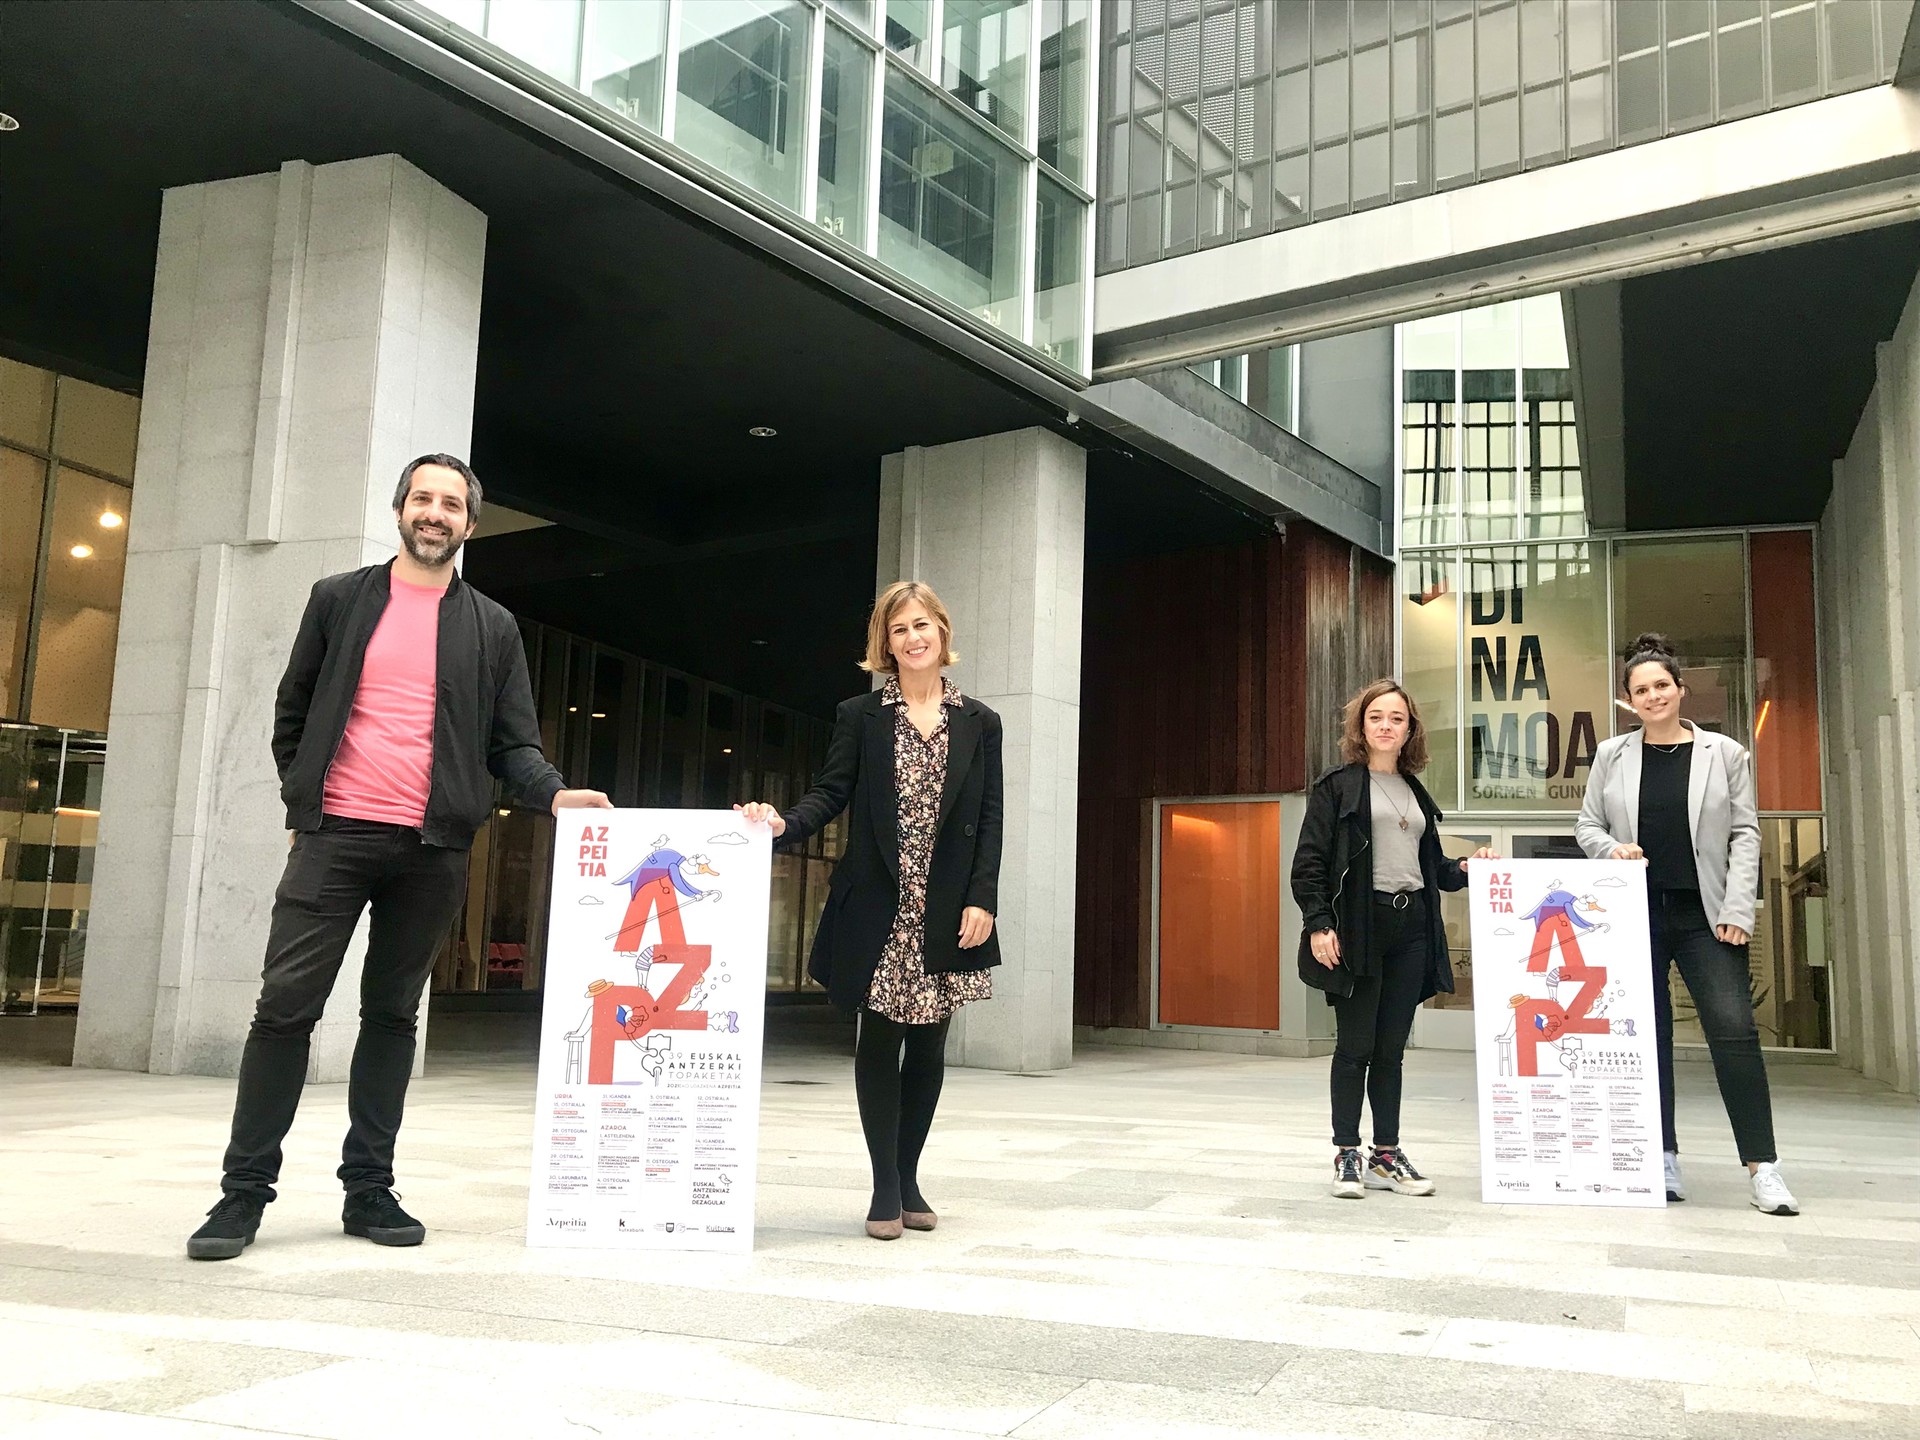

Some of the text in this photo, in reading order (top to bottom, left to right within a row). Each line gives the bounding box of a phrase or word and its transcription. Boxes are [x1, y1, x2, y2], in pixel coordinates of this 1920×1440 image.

[1471, 560, 1523, 625] DI
[1472, 635, 1550, 701] NA
[1472, 711, 1598, 779] MOA
[1472, 785, 1536, 799] SORMEN
[579, 845, 608, 860] PEI
[578, 862, 607, 877] TIA
[1490, 888, 1513, 900] PEI
[1489, 902, 1514, 913] TIA
[668, 1052, 741, 1061] 39 EUSKAL
[668, 1062, 741, 1070] ANTZERKI
[668, 1071, 741, 1080] TOPAKETAK
